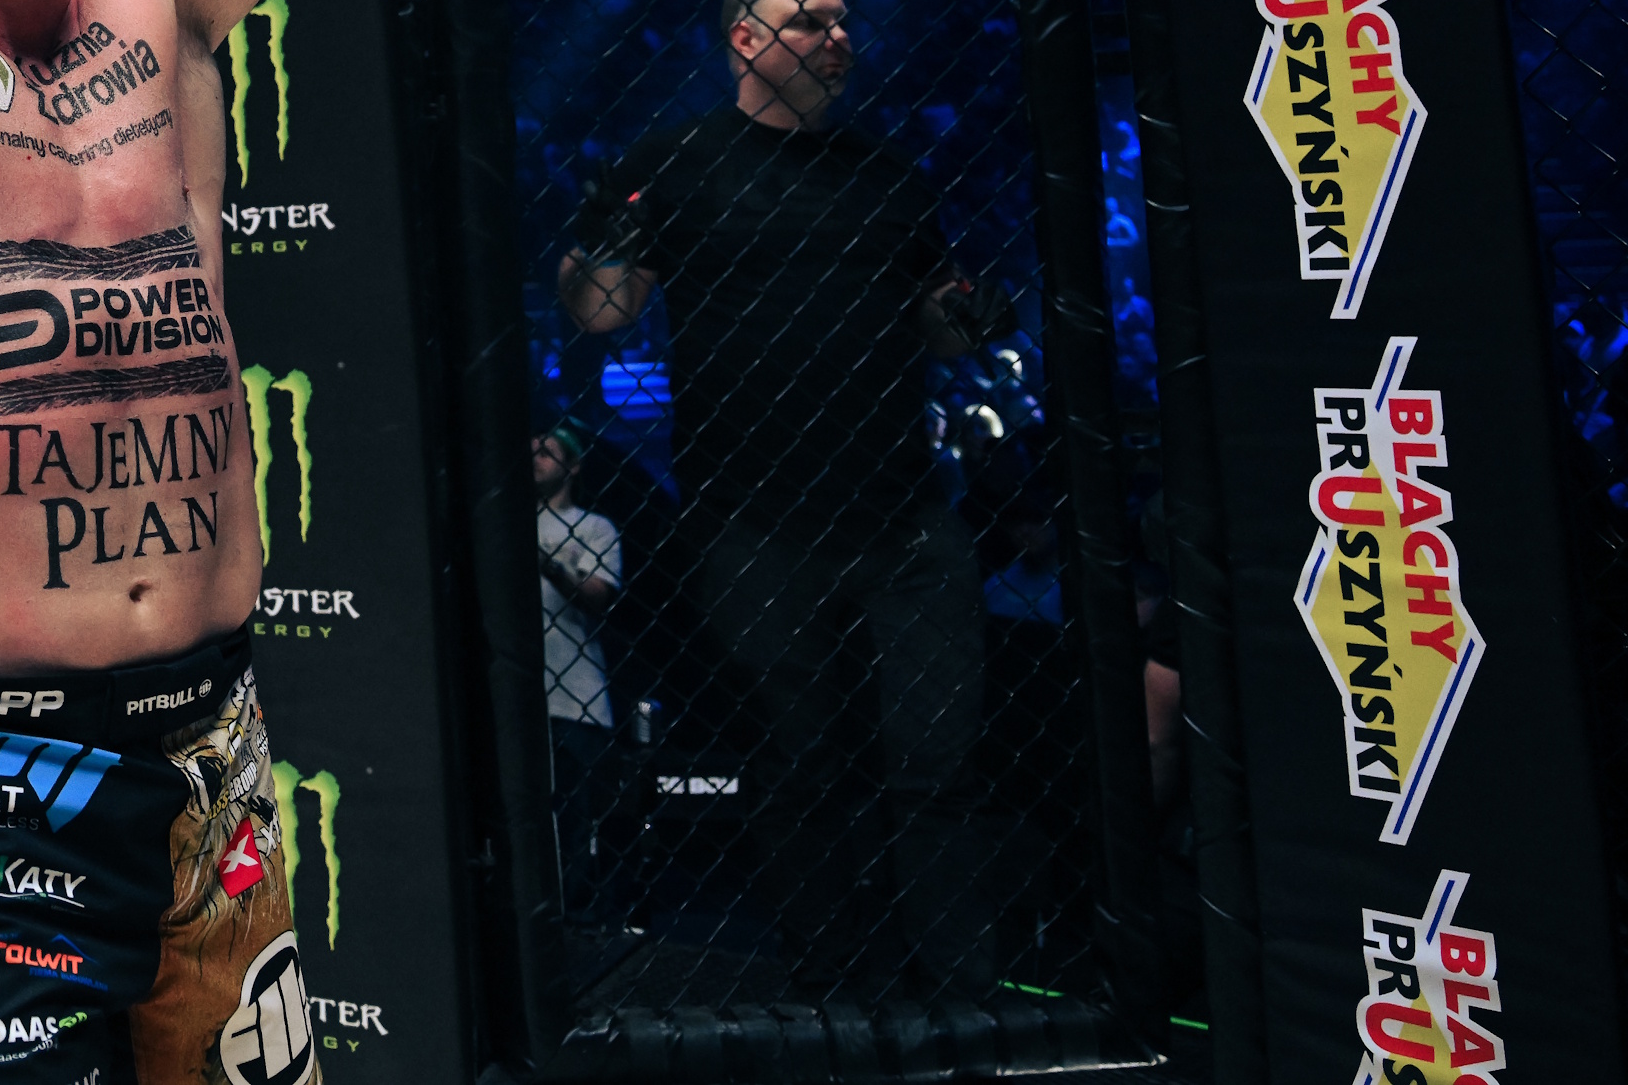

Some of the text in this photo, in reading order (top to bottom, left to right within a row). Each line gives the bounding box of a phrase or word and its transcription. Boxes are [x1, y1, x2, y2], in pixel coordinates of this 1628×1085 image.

[113, 107, 174, 149] dietetyczny
[70, 278, 212, 320] POWER
[75, 314, 225, 357] DIVISION
[39, 491, 219, 590] PLAN
[1388, 398, 1458, 665] BLACHY
[1318, 396, 1403, 795] PRUSZYŃSKI
[126, 686, 196, 716] PITBULL
[306, 996, 389, 1036] TER
